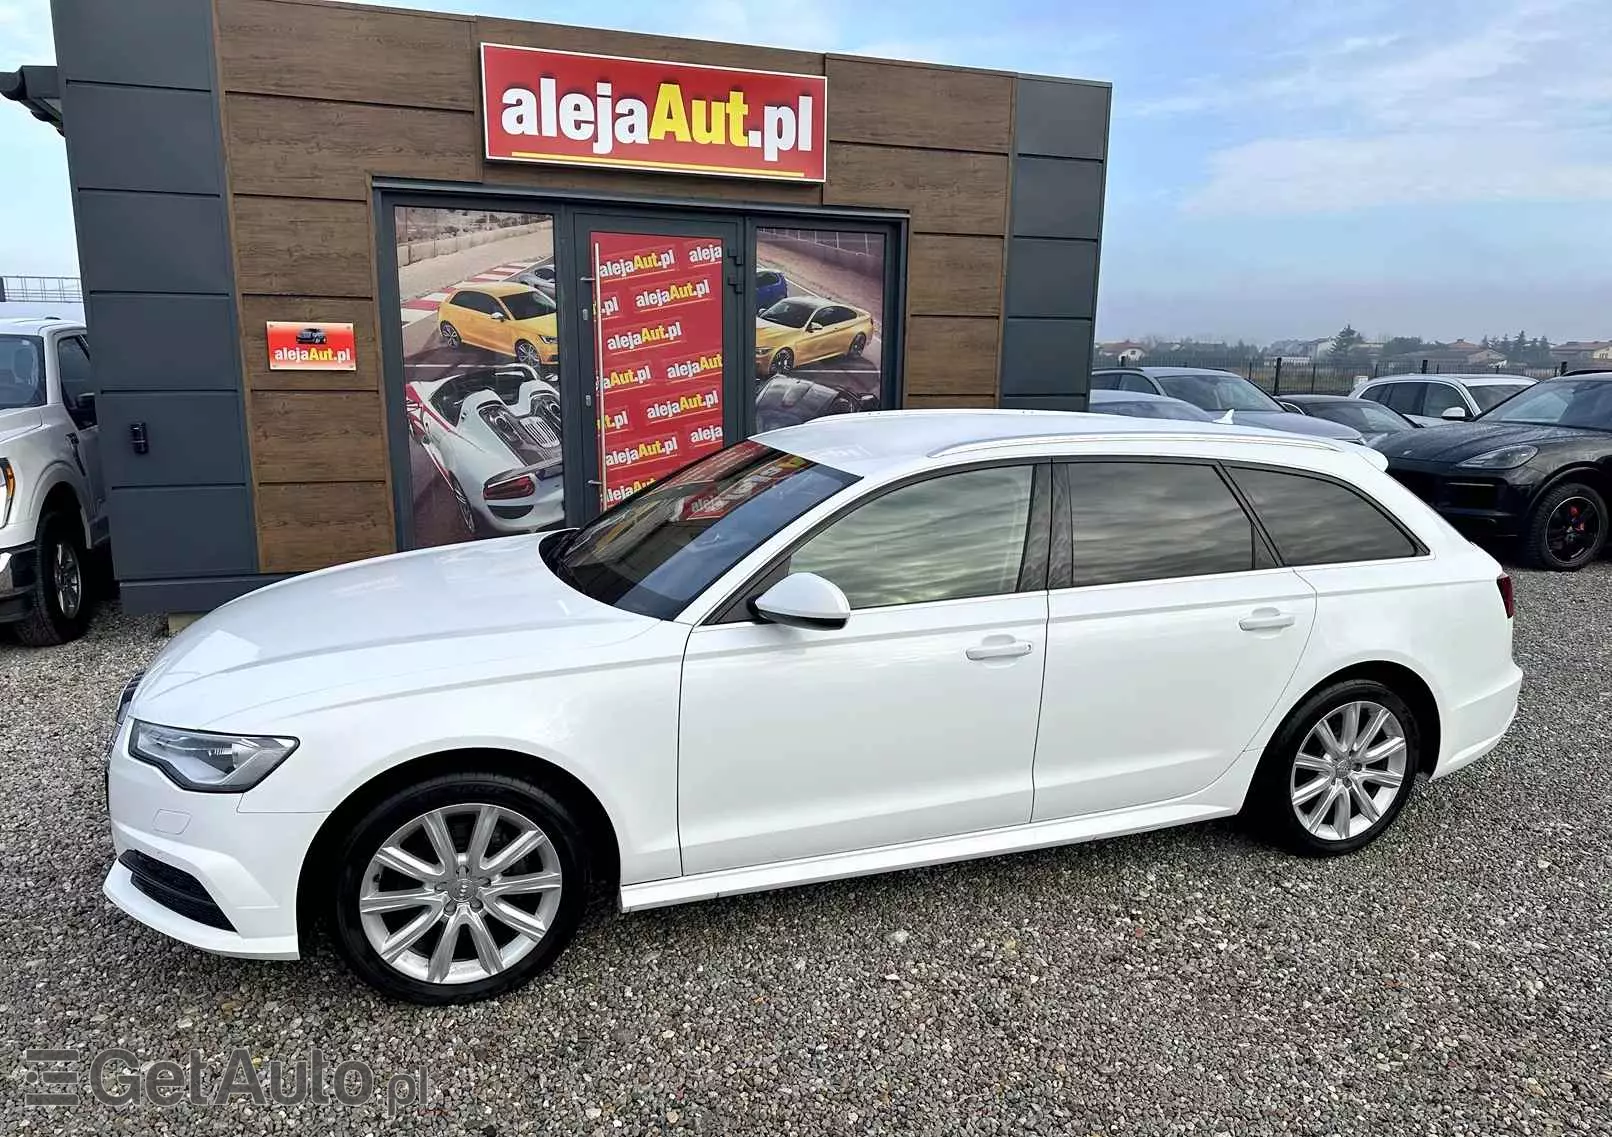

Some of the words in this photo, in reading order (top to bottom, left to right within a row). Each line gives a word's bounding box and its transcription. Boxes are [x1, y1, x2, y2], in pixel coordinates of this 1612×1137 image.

[501, 77, 812, 162] alejaAut.pl
[600, 250, 675, 277] alejaAut.pl
[689, 245, 722, 263] aleja
[635, 280, 710, 307] alejaAut.pl
[607, 322, 682, 350] alejaAut.pl
[274, 347, 351, 363] alejaAut.pl
[646, 390, 719, 419] alejaAut.pl
[690, 425, 723, 443] aleja
[605, 437, 678, 466] alejaAut.pl
